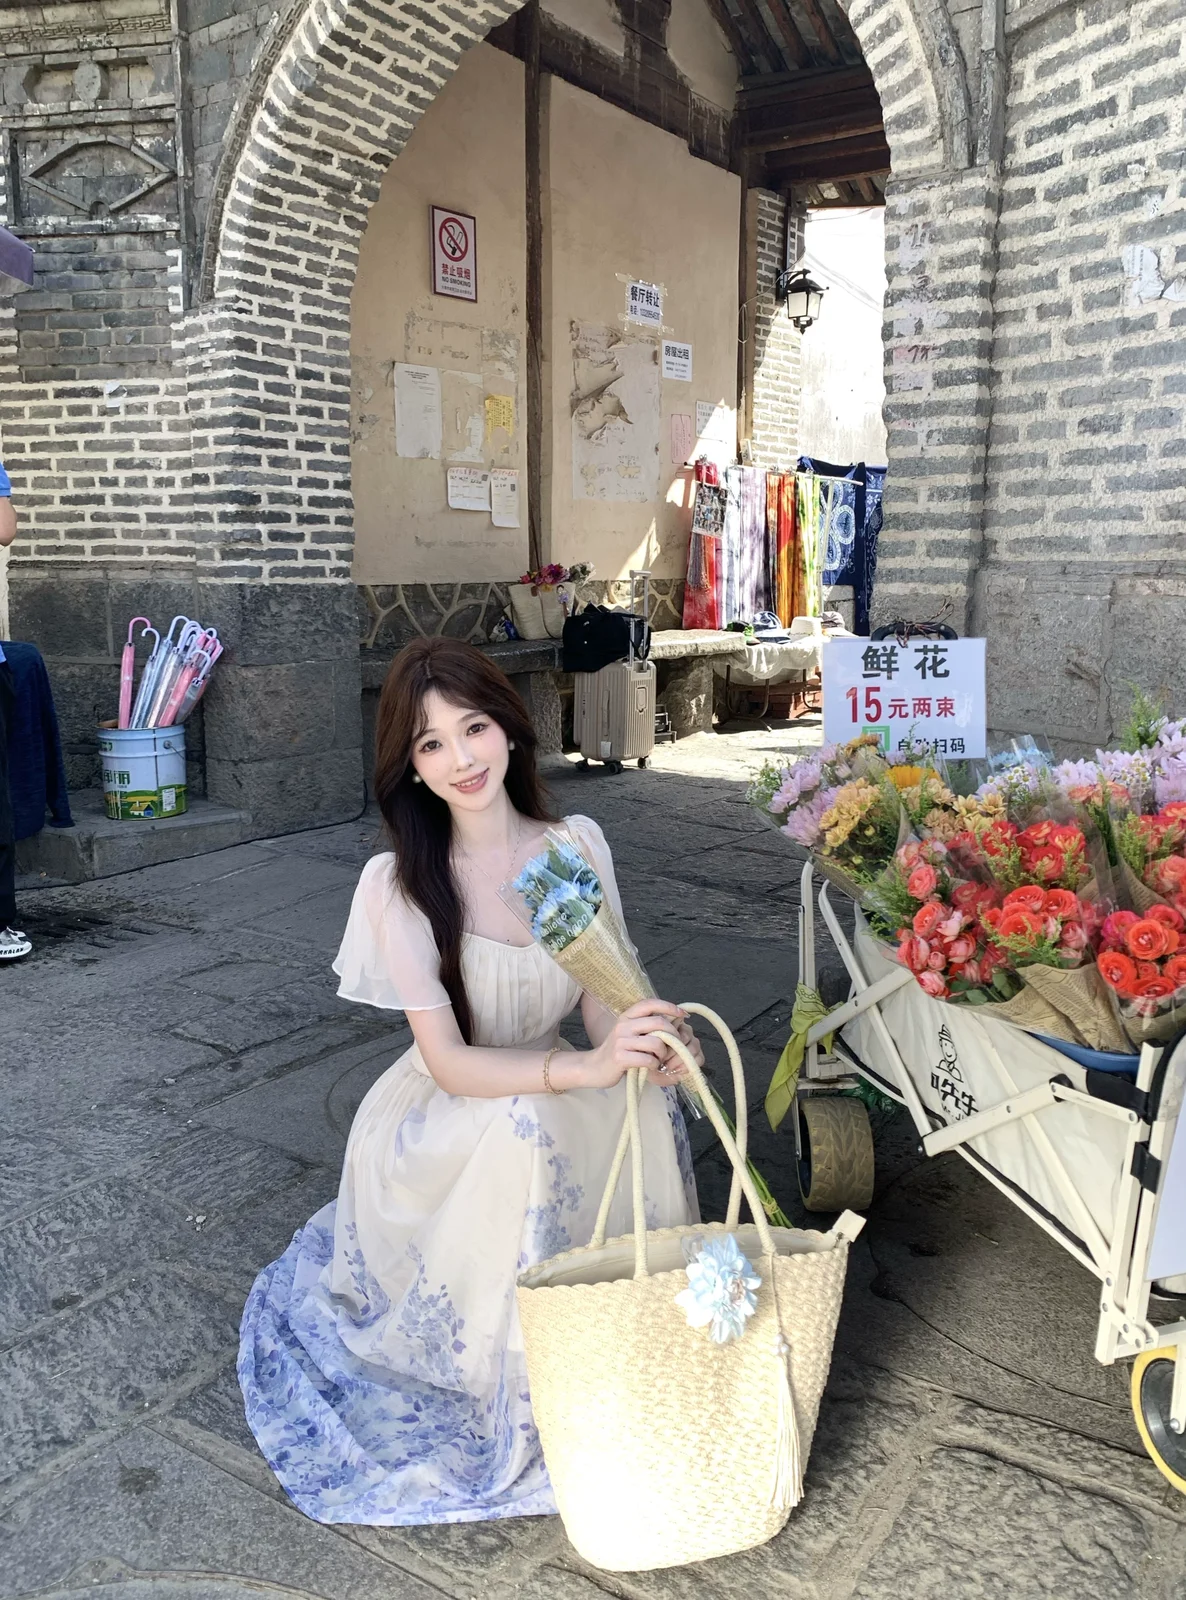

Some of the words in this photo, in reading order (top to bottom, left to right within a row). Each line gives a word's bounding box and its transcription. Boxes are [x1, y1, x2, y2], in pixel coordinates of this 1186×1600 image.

[441, 263, 471, 280] 禁止吸烟
[450, 277, 471, 287] SMOKING
[630, 285, 660, 307] 餐厅转让
[665, 345, 689, 359] 房屋出租
[571, 940, 586, 954] day
